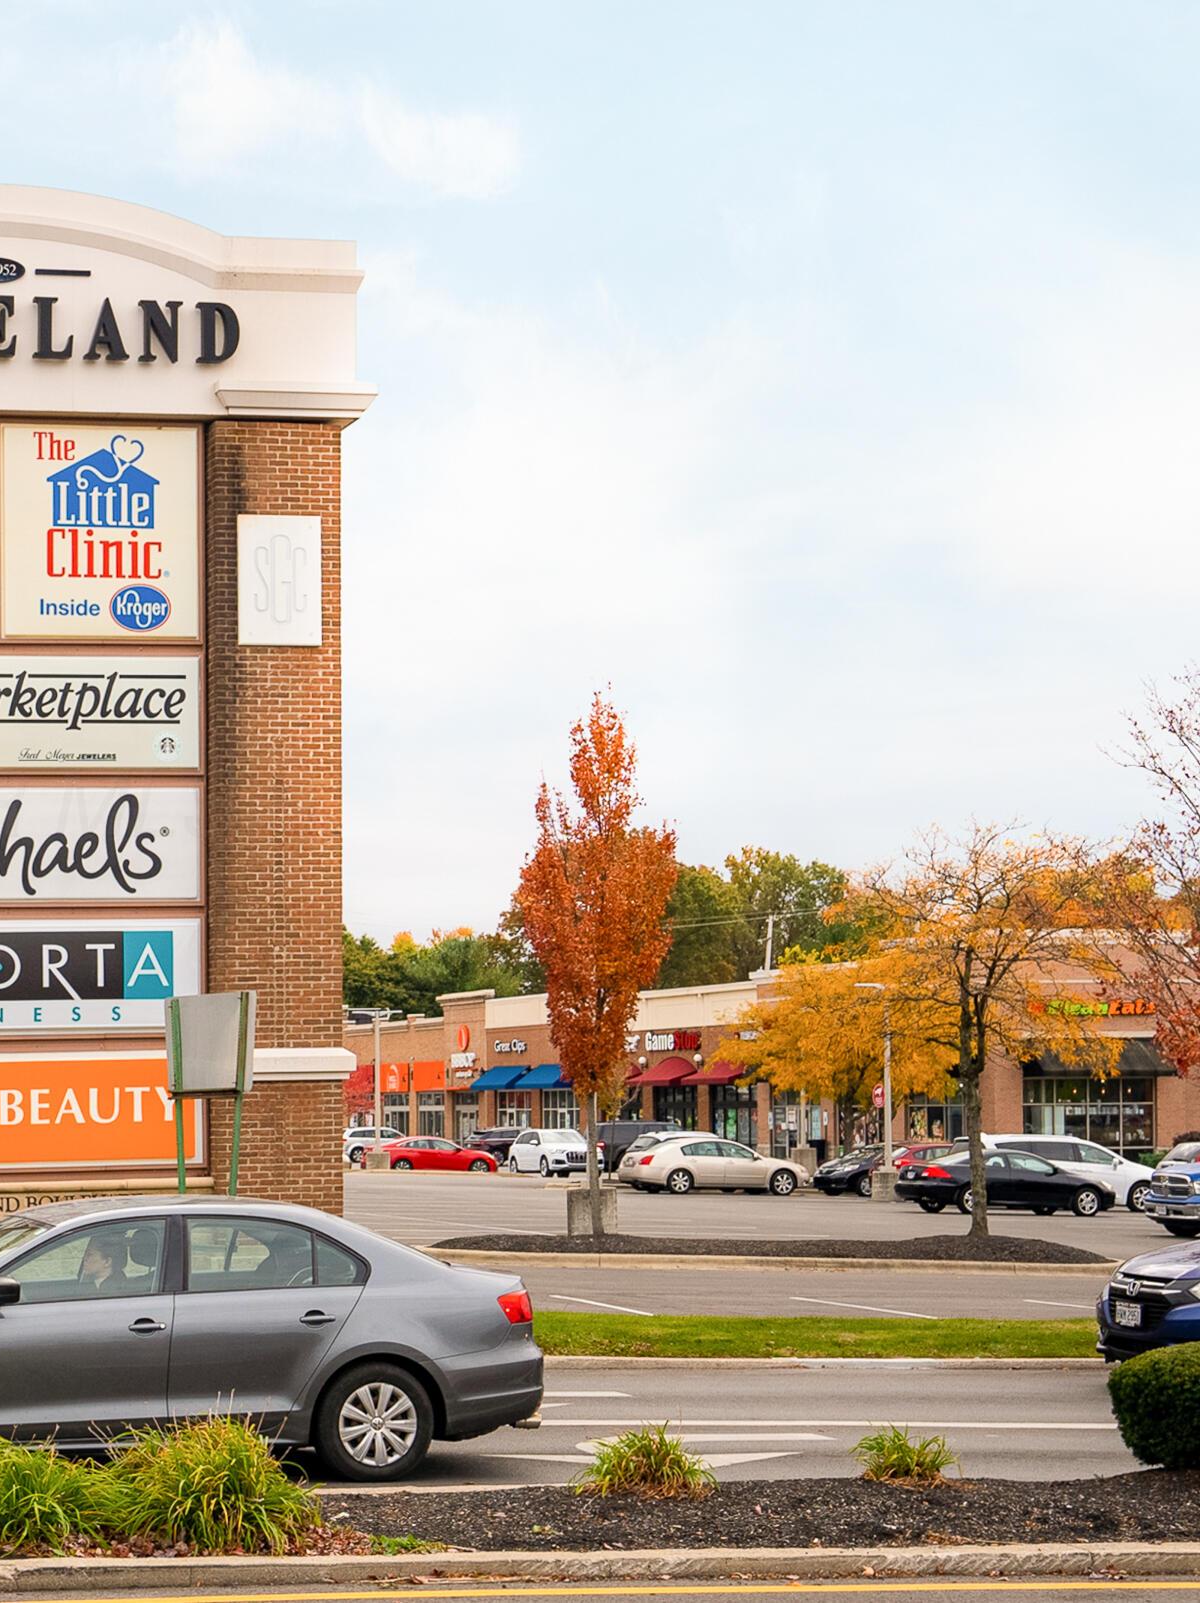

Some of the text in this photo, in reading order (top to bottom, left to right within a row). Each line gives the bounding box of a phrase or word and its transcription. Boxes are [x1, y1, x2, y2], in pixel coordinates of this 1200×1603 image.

[33, 431, 76, 461] The
[56, 481, 150, 527] Little
[46, 528, 163, 580] Clinic
[39, 589, 168, 629] Inside Kroger
[0, 1086, 176, 1126] BEAUTY
